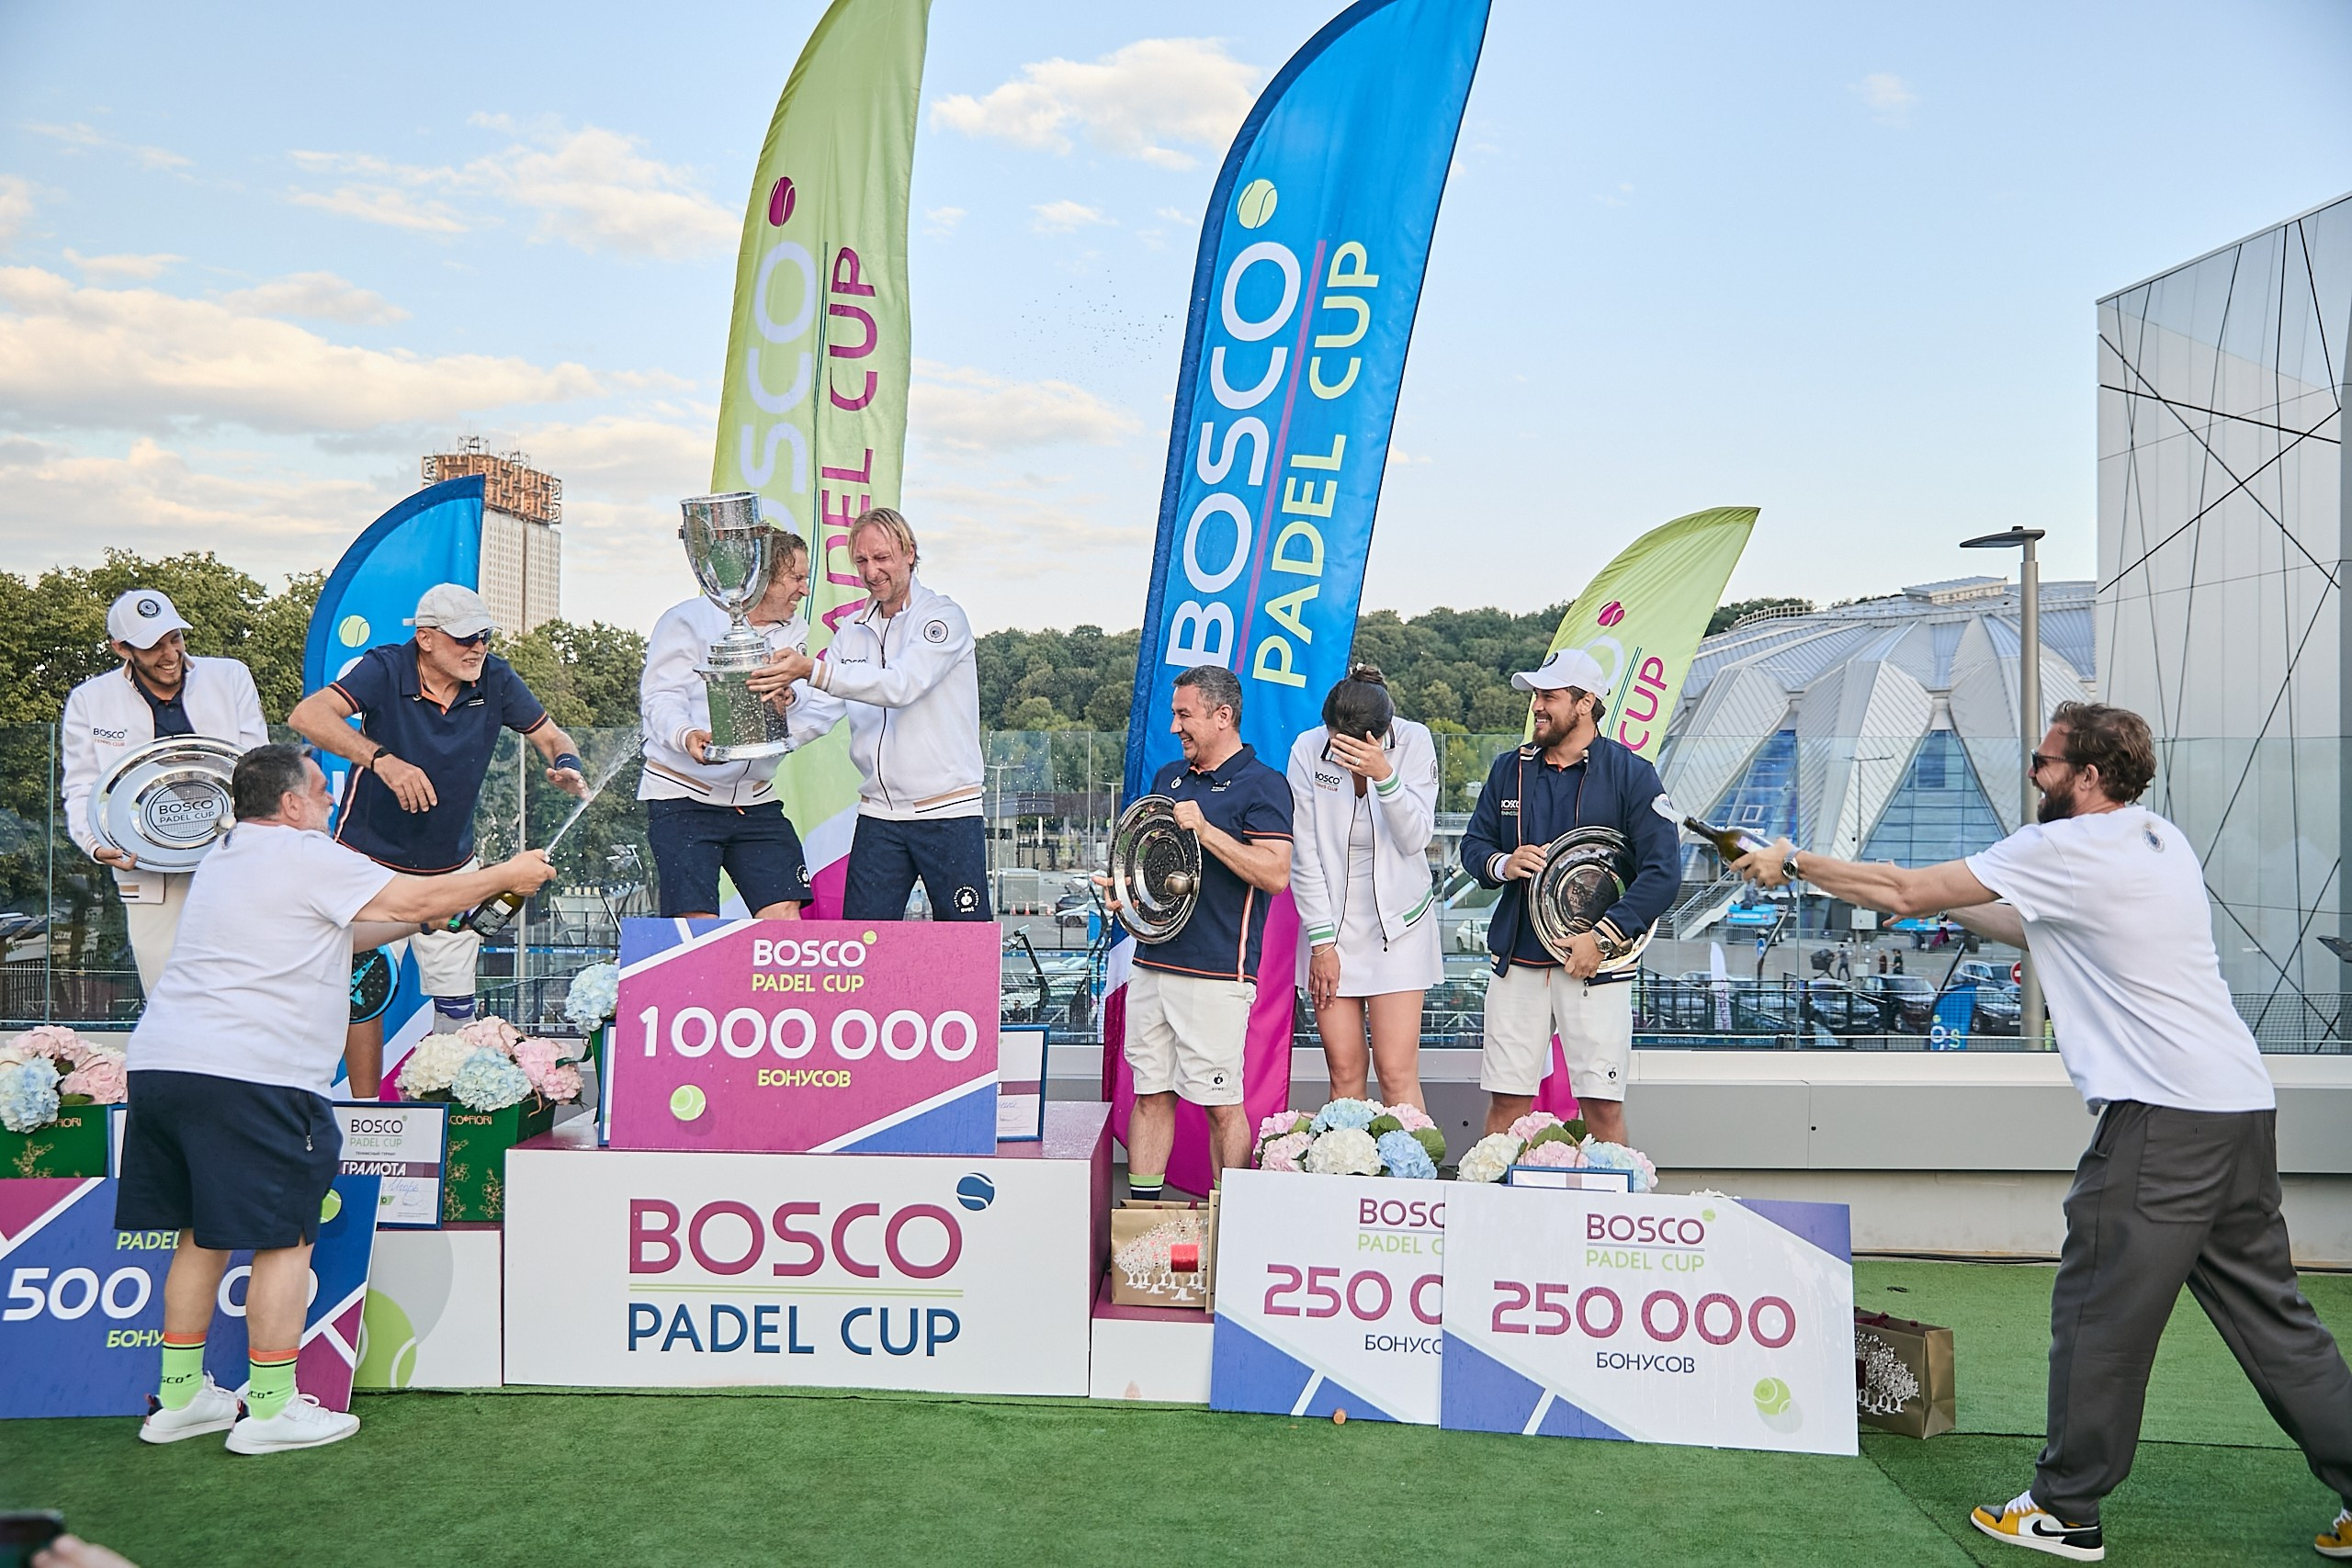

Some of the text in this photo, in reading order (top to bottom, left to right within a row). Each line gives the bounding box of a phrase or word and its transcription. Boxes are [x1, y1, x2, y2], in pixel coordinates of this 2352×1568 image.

[830, 246, 877, 412] CUP
[1165, 242, 1301, 669] BOSCO
[1252, 242, 1379, 688] PADEL CUP
[1619, 657, 1667, 751] CUP
[93, 728, 125, 739] BOSCO
[159, 799, 214, 815] BOSCO
[159, 811, 215, 824] PADEL CUP
[753, 939, 866, 967] BOSCO
[752, 974, 865, 993] PADEL CUP
[831, 1009, 978, 1062] 000
[758, 1068, 852, 1088] БОНУСОВ
[351, 1119, 403, 1134] BOSCO
[350, 1137, 402, 1147] PADEL CUP
[343, 1161, 406, 1176] ГРАМОТА
[1359, 1198, 1445, 1228] BOSC
[629, 1199, 963, 1279] BOSCO
[1587, 1213, 1704, 1245] BOSCO
[1357, 1233, 1422, 1255] PADEL
[1586, 1249, 1704, 1272] PADEL CUP
[3, 1267, 152, 1321] 500
[1264, 1263, 1392, 1321] 250
[1492, 1280, 1623, 1338] 250
[1641, 1290, 1796, 1348] 000
[628, 1303, 961, 1357] PADEL CUP
[1596, 1352, 1695, 1373] БОНУСОВ
